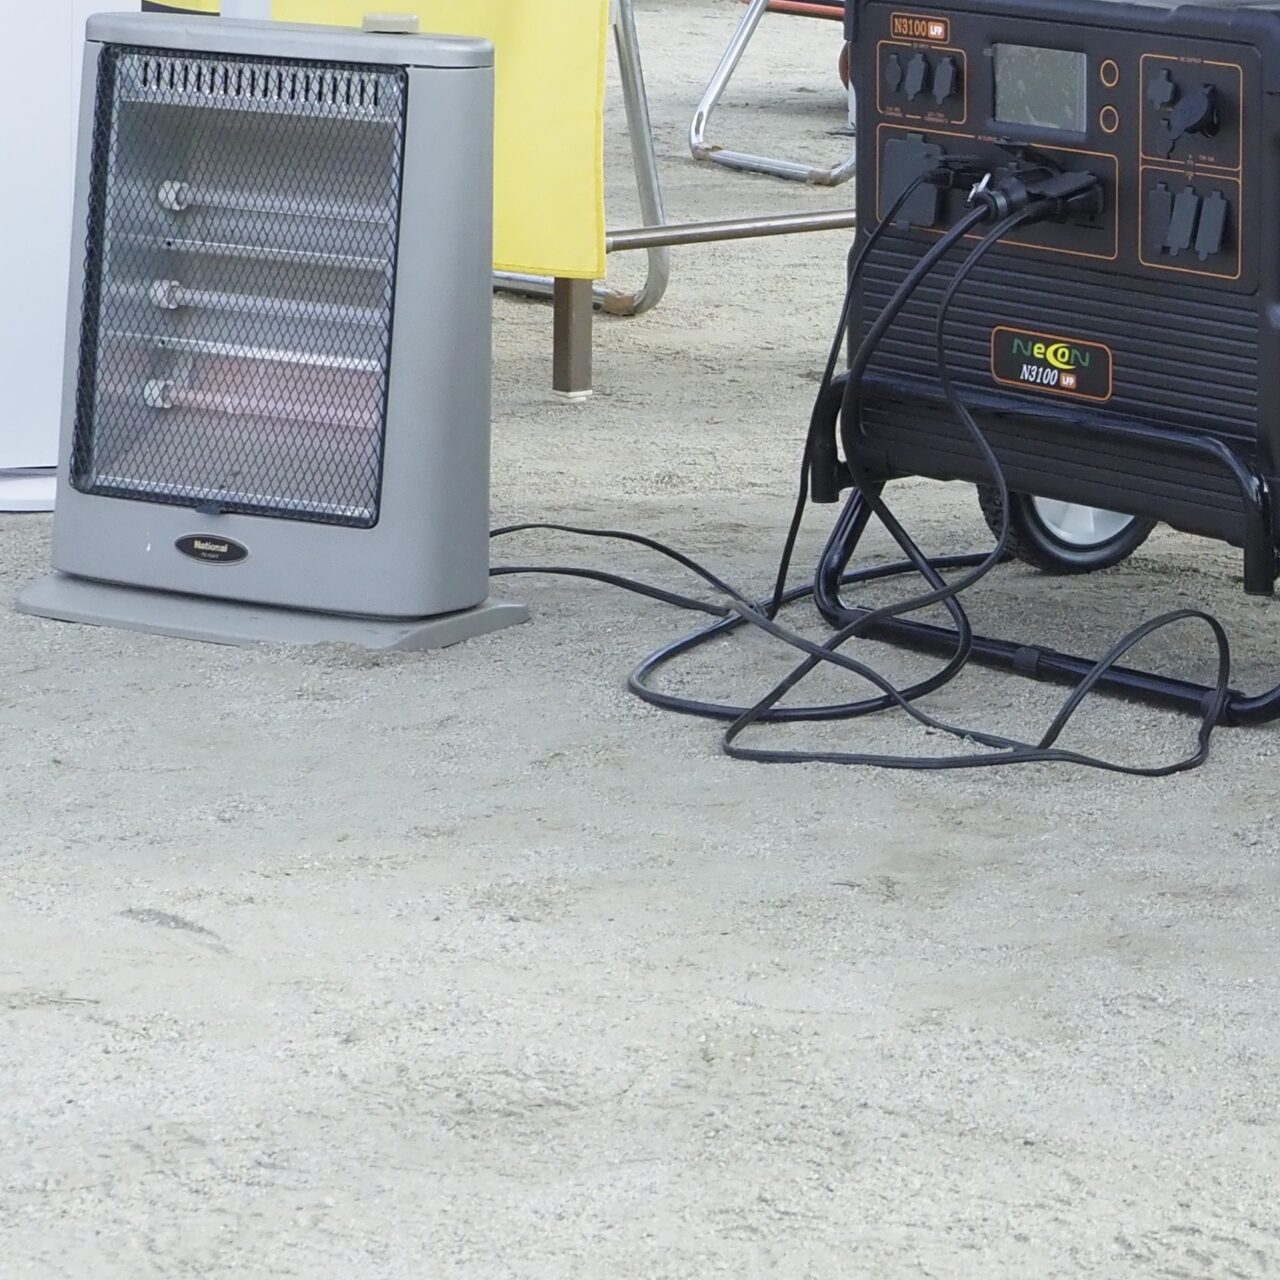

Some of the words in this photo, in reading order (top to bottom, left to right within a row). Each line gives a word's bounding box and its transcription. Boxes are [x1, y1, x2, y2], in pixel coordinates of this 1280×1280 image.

[894, 18, 927, 36] N3100
[929, 24, 943, 37] LFP
[1020, 364, 1058, 385] N3100
[1061, 375, 1075, 387] LFP
[194, 540, 228, 553] National
